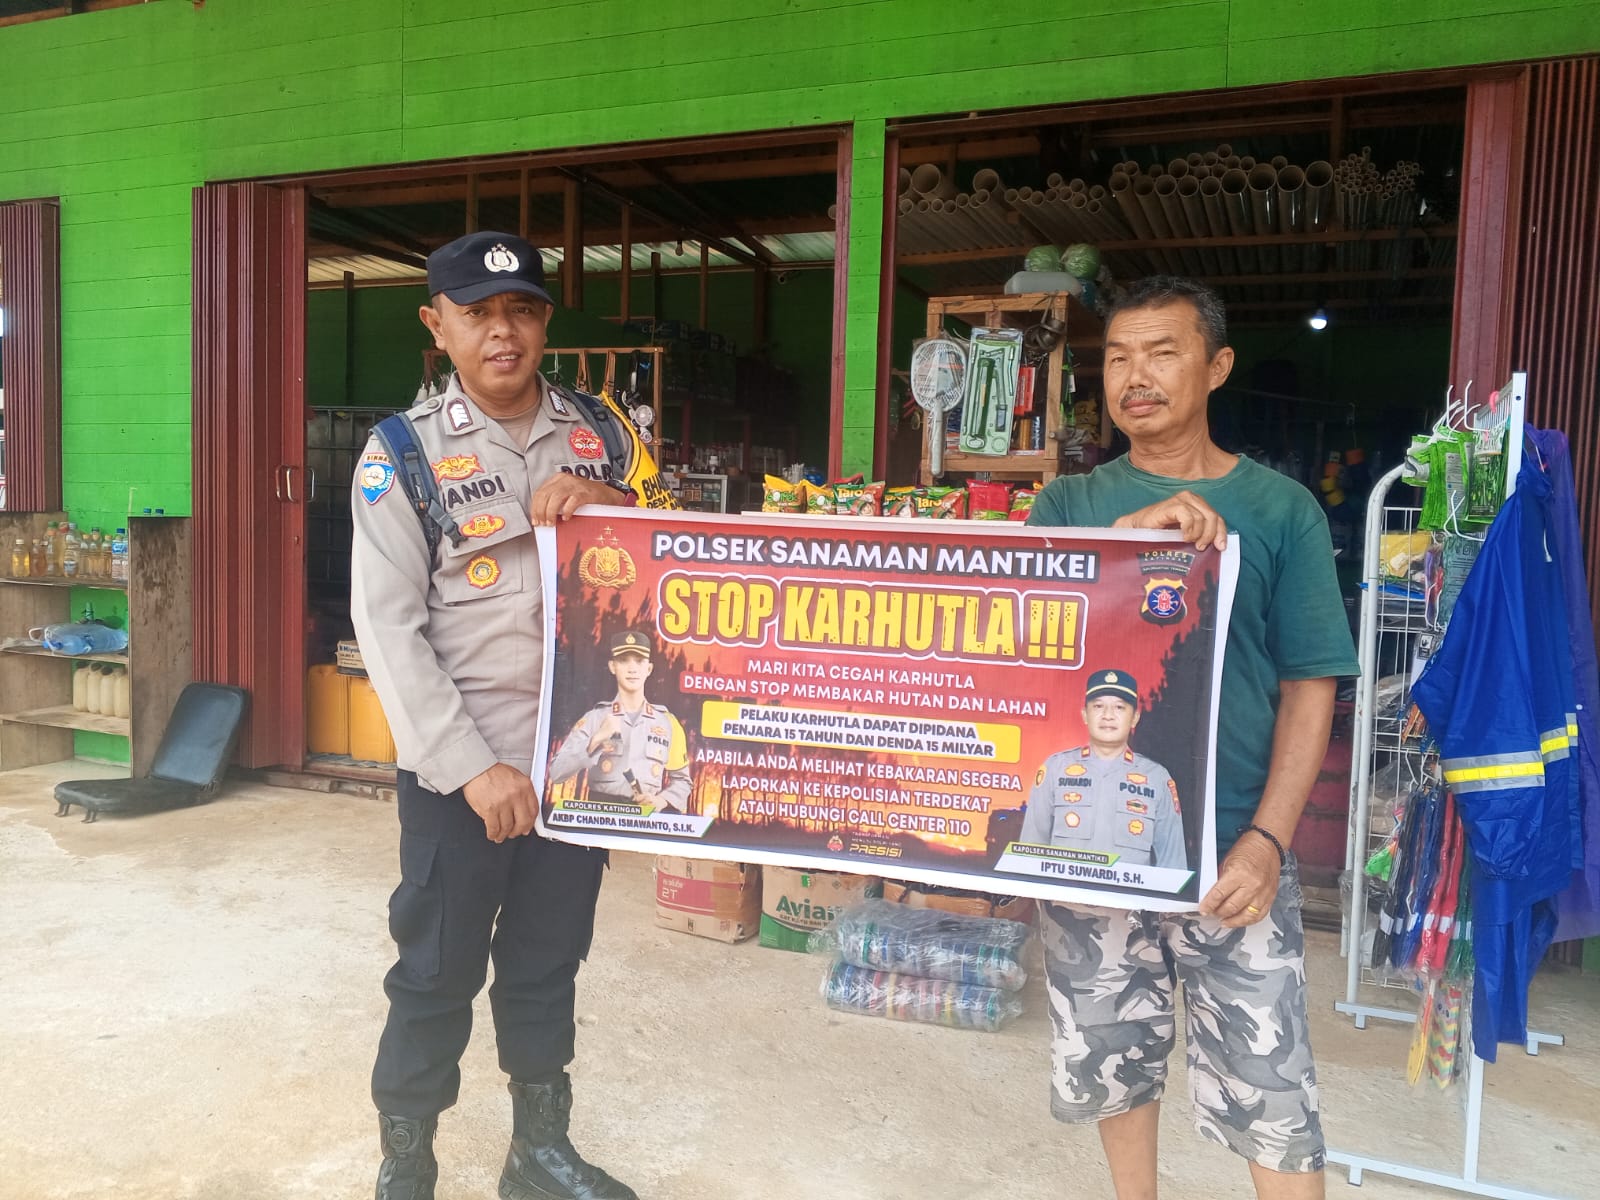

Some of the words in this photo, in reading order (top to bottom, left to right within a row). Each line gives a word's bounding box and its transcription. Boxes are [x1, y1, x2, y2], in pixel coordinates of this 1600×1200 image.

[367, 455, 391, 463] BINMA
[448, 475, 505, 509] ANDI
[837, 488, 863, 499] Taro
[655, 534, 768, 562] POLSEK
[771, 538, 930, 571] SANAMAN
[936, 548, 1096, 579] MANTIKEI
[1144, 551, 1188, 559] POLRES
[664, 578, 774, 640] STOP
[783, 586, 1016, 657] KARHUTLA
[1028, 600, 1079, 661] !!!
[747, 660, 788, 675] MARI
[792, 663, 826, 678] KITA
[829, 665, 884, 682] CEGAH
[889, 670, 975, 690] KARHUTLA
[684, 675, 746, 692] DENGAN
[750, 681, 790, 696] STOP
[793, 685, 884, 704] MEMBAKAR
[888, 691, 944, 708] HUTAN
[948, 696, 983, 711] DAN
[988, 699, 1046, 717] LAHAN
[741, 708, 789, 724] PELAKU
[791, 713, 860, 730] KARHUTLA
[863, 719, 906, 733] DAPAT
[909, 723, 977, 739] DIPIDANA
[724, 723, 780, 739] PENJARA
[784, 728, 796, 740] 15
[798, 729, 843, 744] TAHUN
[846, 733, 875, 747] DAN
[877, 737, 923, 751] DENDA
[926, 740, 939, 752] 15
[942, 742, 994, 757] MILYAR
[696, 749, 754, 768] APABILA
[757, 754, 799, 771] ANDA
[801, 758, 865, 776] MELIHAT
[867, 763, 957, 785] KEBAKARAN
[961, 770, 1023, 791] SEGERA
[1058, 777, 1092, 787] SUWARDI
[1119, 782, 1155, 799] POLRI
[722, 776, 800, 795] LAPORKAN
[804, 783, 822, 797] KE
[824, 784, 911, 805] KEPOLISIAN
[913, 791, 990, 813] TERDEKAT
[564, 801, 601, 811] KAPOLRES
[603, 804, 641, 814] KATINGAN
[739, 800, 775, 815] ATAU
[779, 803, 845, 822] HUBUNGI
[848, 809, 885, 827] CALL
[887, 815, 946, 833] CENTER
[950, 819, 970, 836] 110
[553, 813, 575, 823] AKBP
[577, 816, 617, 826] CHANDRA
[618, 818, 672, 833] ISMAWANTO,
[673, 824, 695, 833] S.I.K.
[849, 843, 903, 858] PRESISI
[1013, 845, 1045, 855] KAPOLSEK
[1046, 849, 1076, 858] SANAMAN
[1078, 852, 1108, 863] MANTIKEI
[1041, 861, 1066, 874] IPTU
[1068, 865, 1120, 883] SUWARDI,
[1122, 872, 1144, 884] S.H.
[662, 887, 678, 899] 2T
